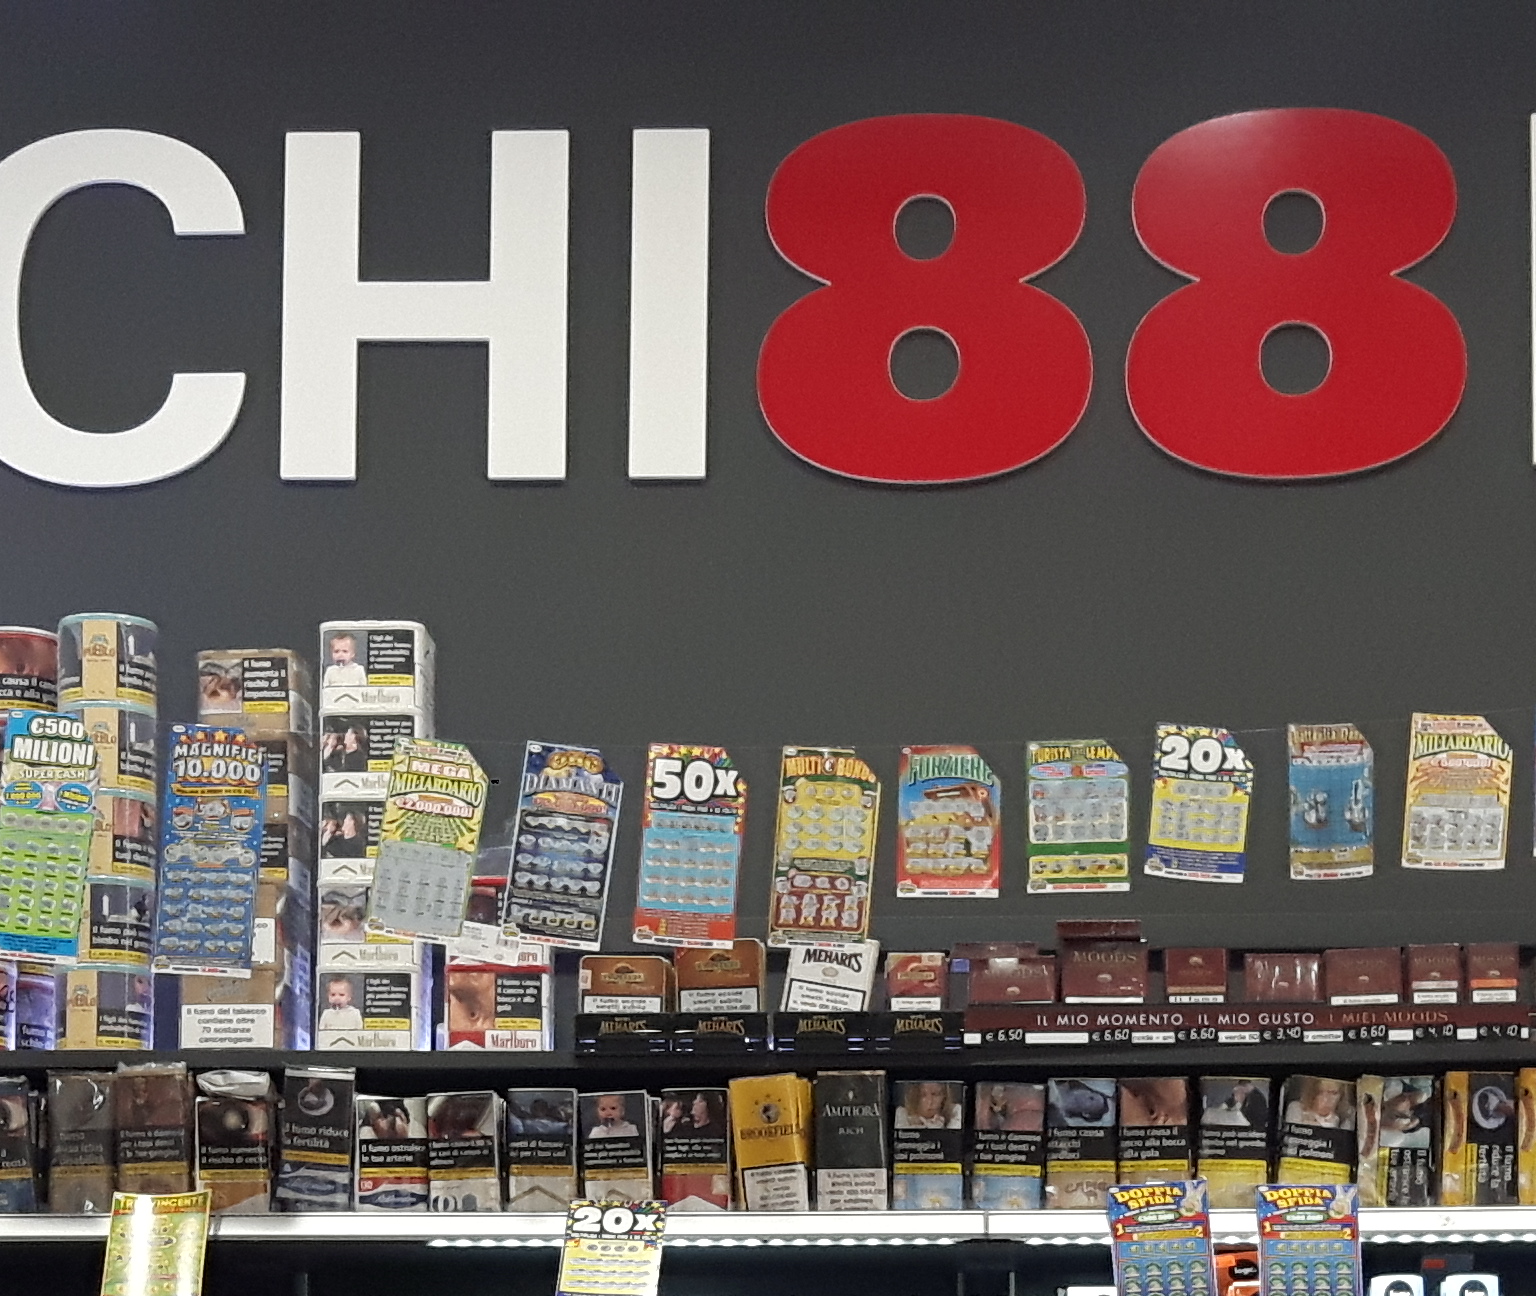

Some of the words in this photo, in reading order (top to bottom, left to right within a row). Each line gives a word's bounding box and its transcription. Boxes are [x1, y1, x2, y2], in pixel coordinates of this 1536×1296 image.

[756, 107, 1467, 484] 88
[13, 737, 95, 767] MILIONI
[176, 759, 261, 782] 10.000
[410, 761, 472, 780] MEGA
[1036, 1015, 1048, 1026] IL
[1057, 1015, 1089, 1026] MIO
[1198, 1014, 1210, 1025] IL
[1218, 1014, 1251, 1025] MIO
[489, 1034, 538, 1049] Marlboro
